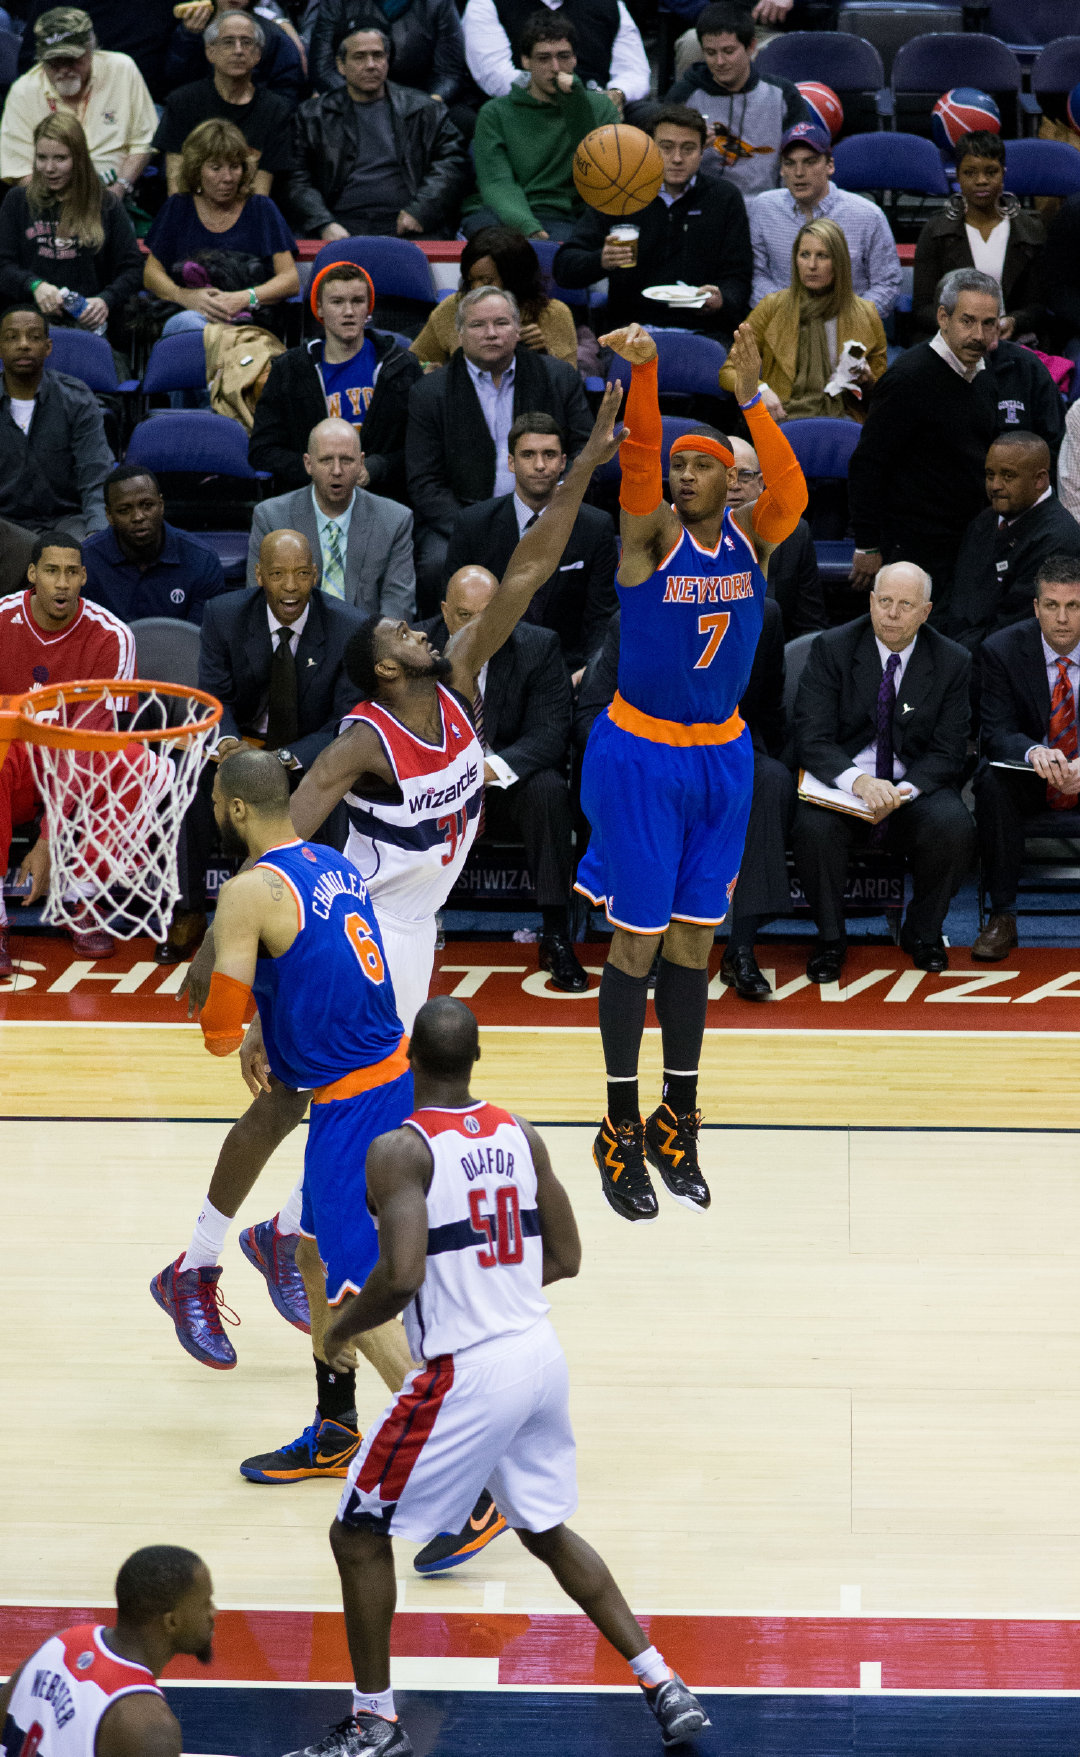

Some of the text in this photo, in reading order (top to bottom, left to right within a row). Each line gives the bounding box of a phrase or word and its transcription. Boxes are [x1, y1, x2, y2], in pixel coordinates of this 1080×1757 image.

[706, 571, 754, 602] YORK
[693, 611, 731, 669] 7
[436, 804, 468, 868] 31
[312, 870, 368, 920] CHANDLER
[343, 911, 385, 986] 6
[460, 1147, 515, 1181] OKAFOR
[467, 1184, 524, 1269] 50
